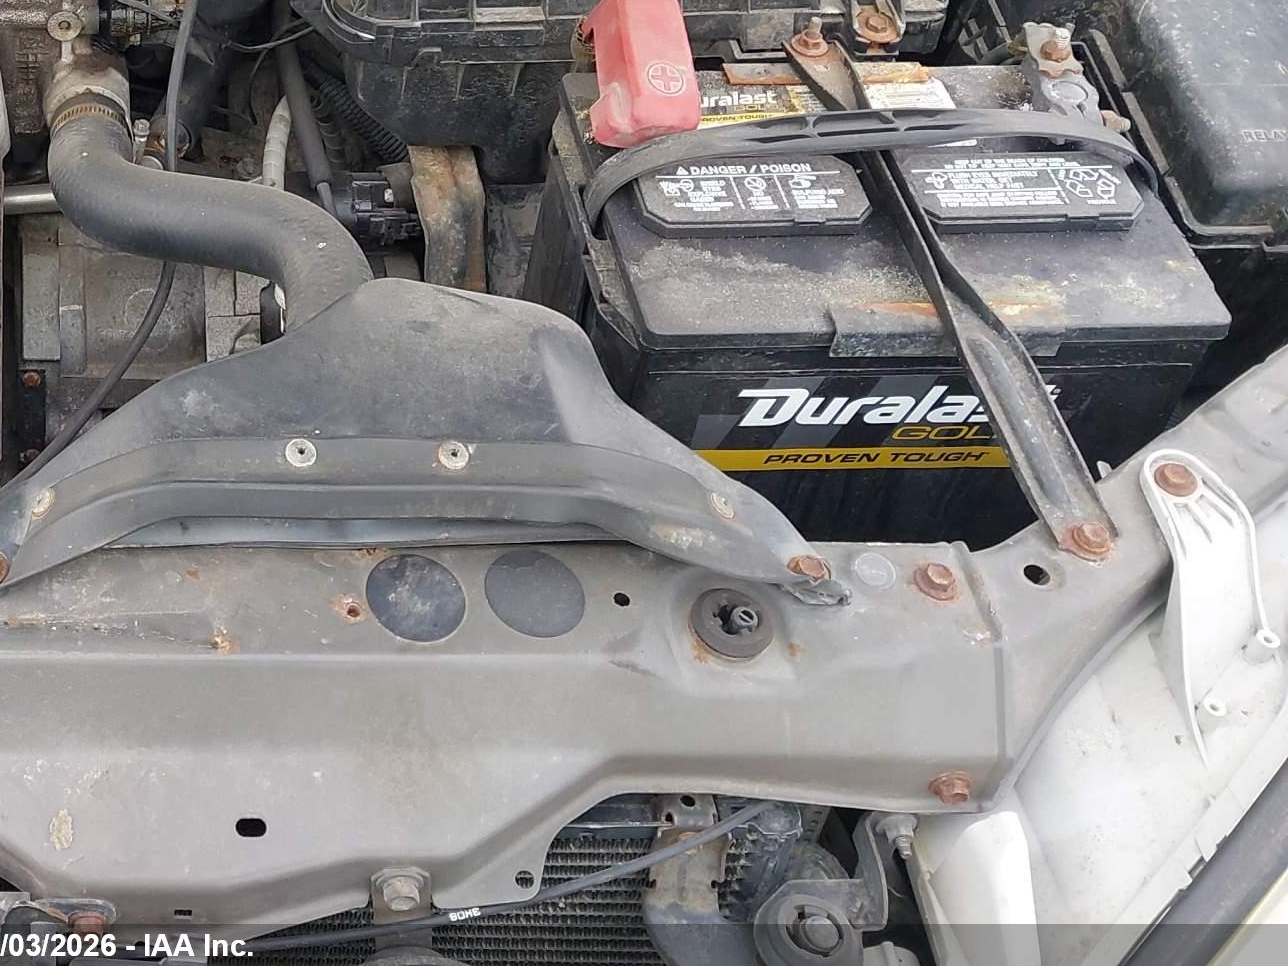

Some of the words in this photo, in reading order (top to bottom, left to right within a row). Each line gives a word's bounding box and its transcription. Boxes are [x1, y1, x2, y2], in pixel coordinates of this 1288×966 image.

[689, 165, 747, 175] DANGER
[760, 163, 812, 173] POISON
[891, 426, 998, 441] GOL
[763, 452, 880, 465] PROVEN
[890, 451, 986, 463] TOUGH
